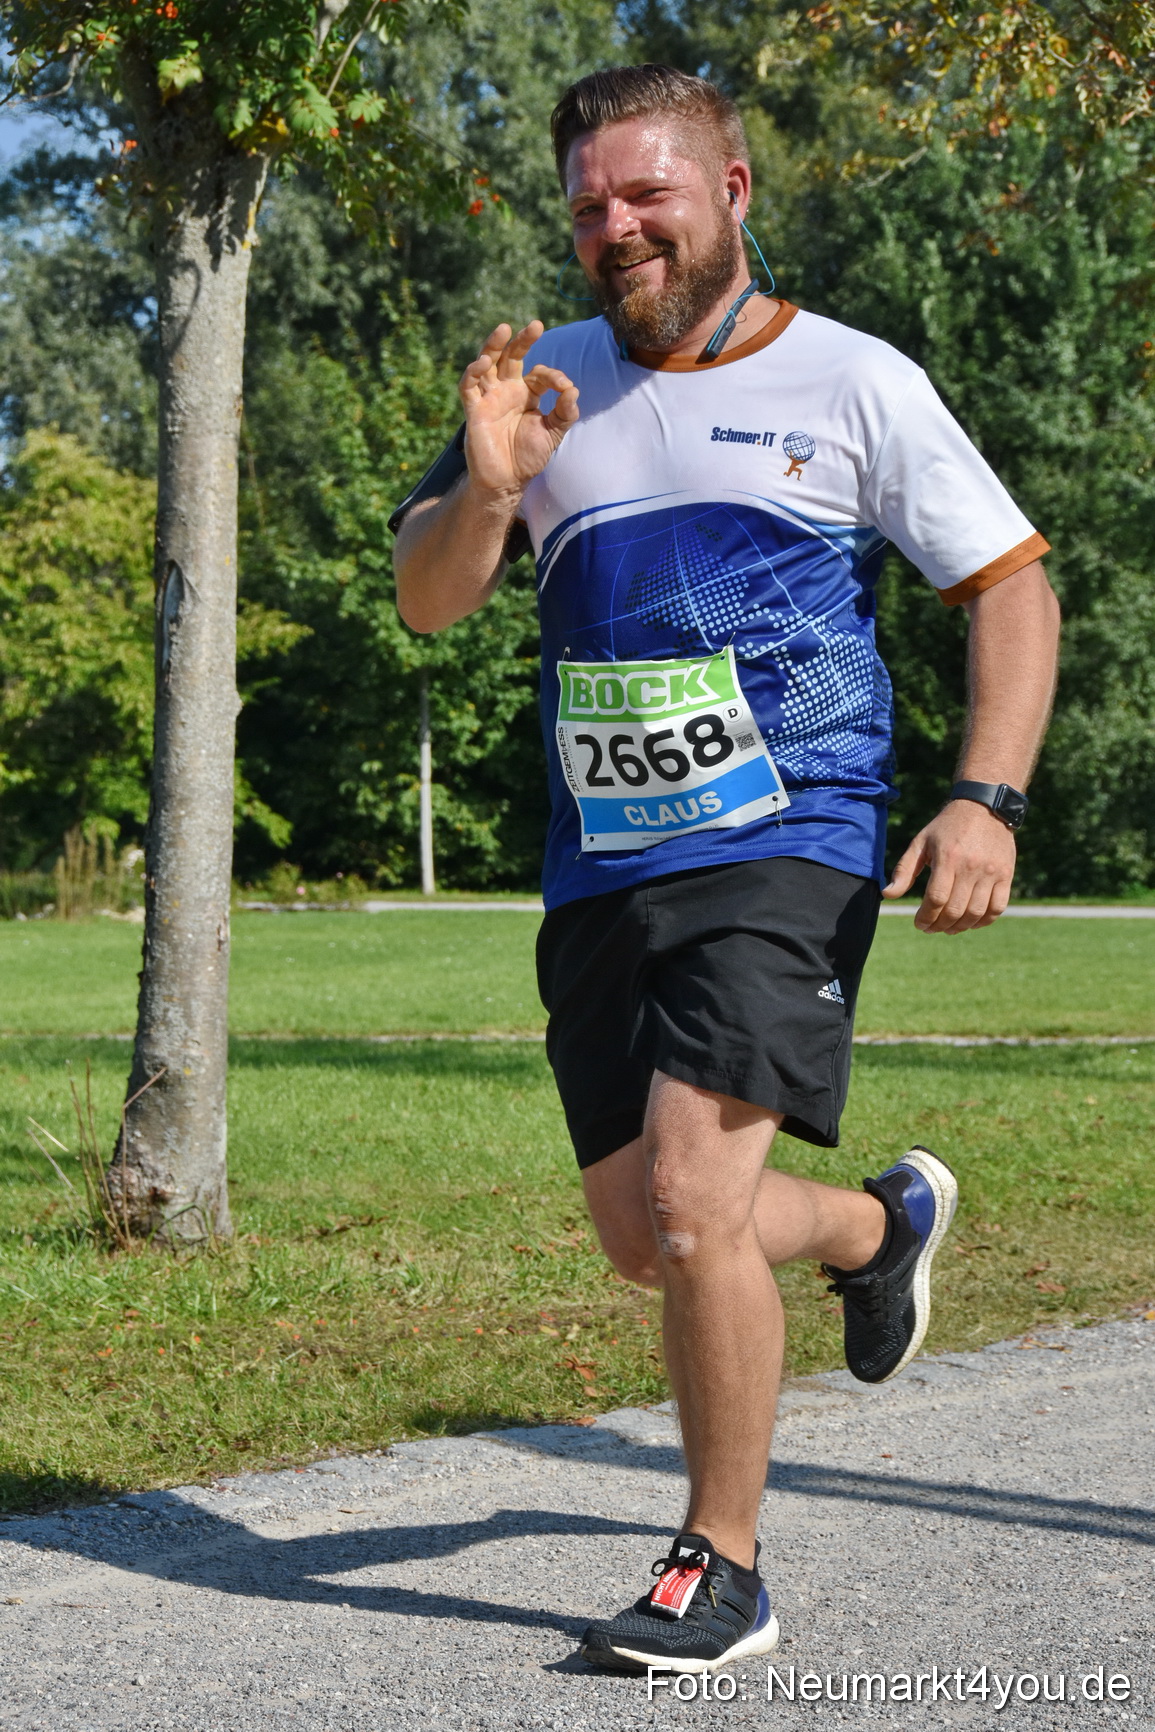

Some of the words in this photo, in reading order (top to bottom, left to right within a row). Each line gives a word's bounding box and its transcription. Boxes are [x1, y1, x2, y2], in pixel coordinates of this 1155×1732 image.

[711, 427, 776, 447] Schmer.IT
[568, 659, 724, 715] BOCK
[727, 708, 738, 718] D
[574, 713, 734, 787] 2668
[623, 790, 723, 827] CLAUS
[817, 990, 845, 1005] adidas
